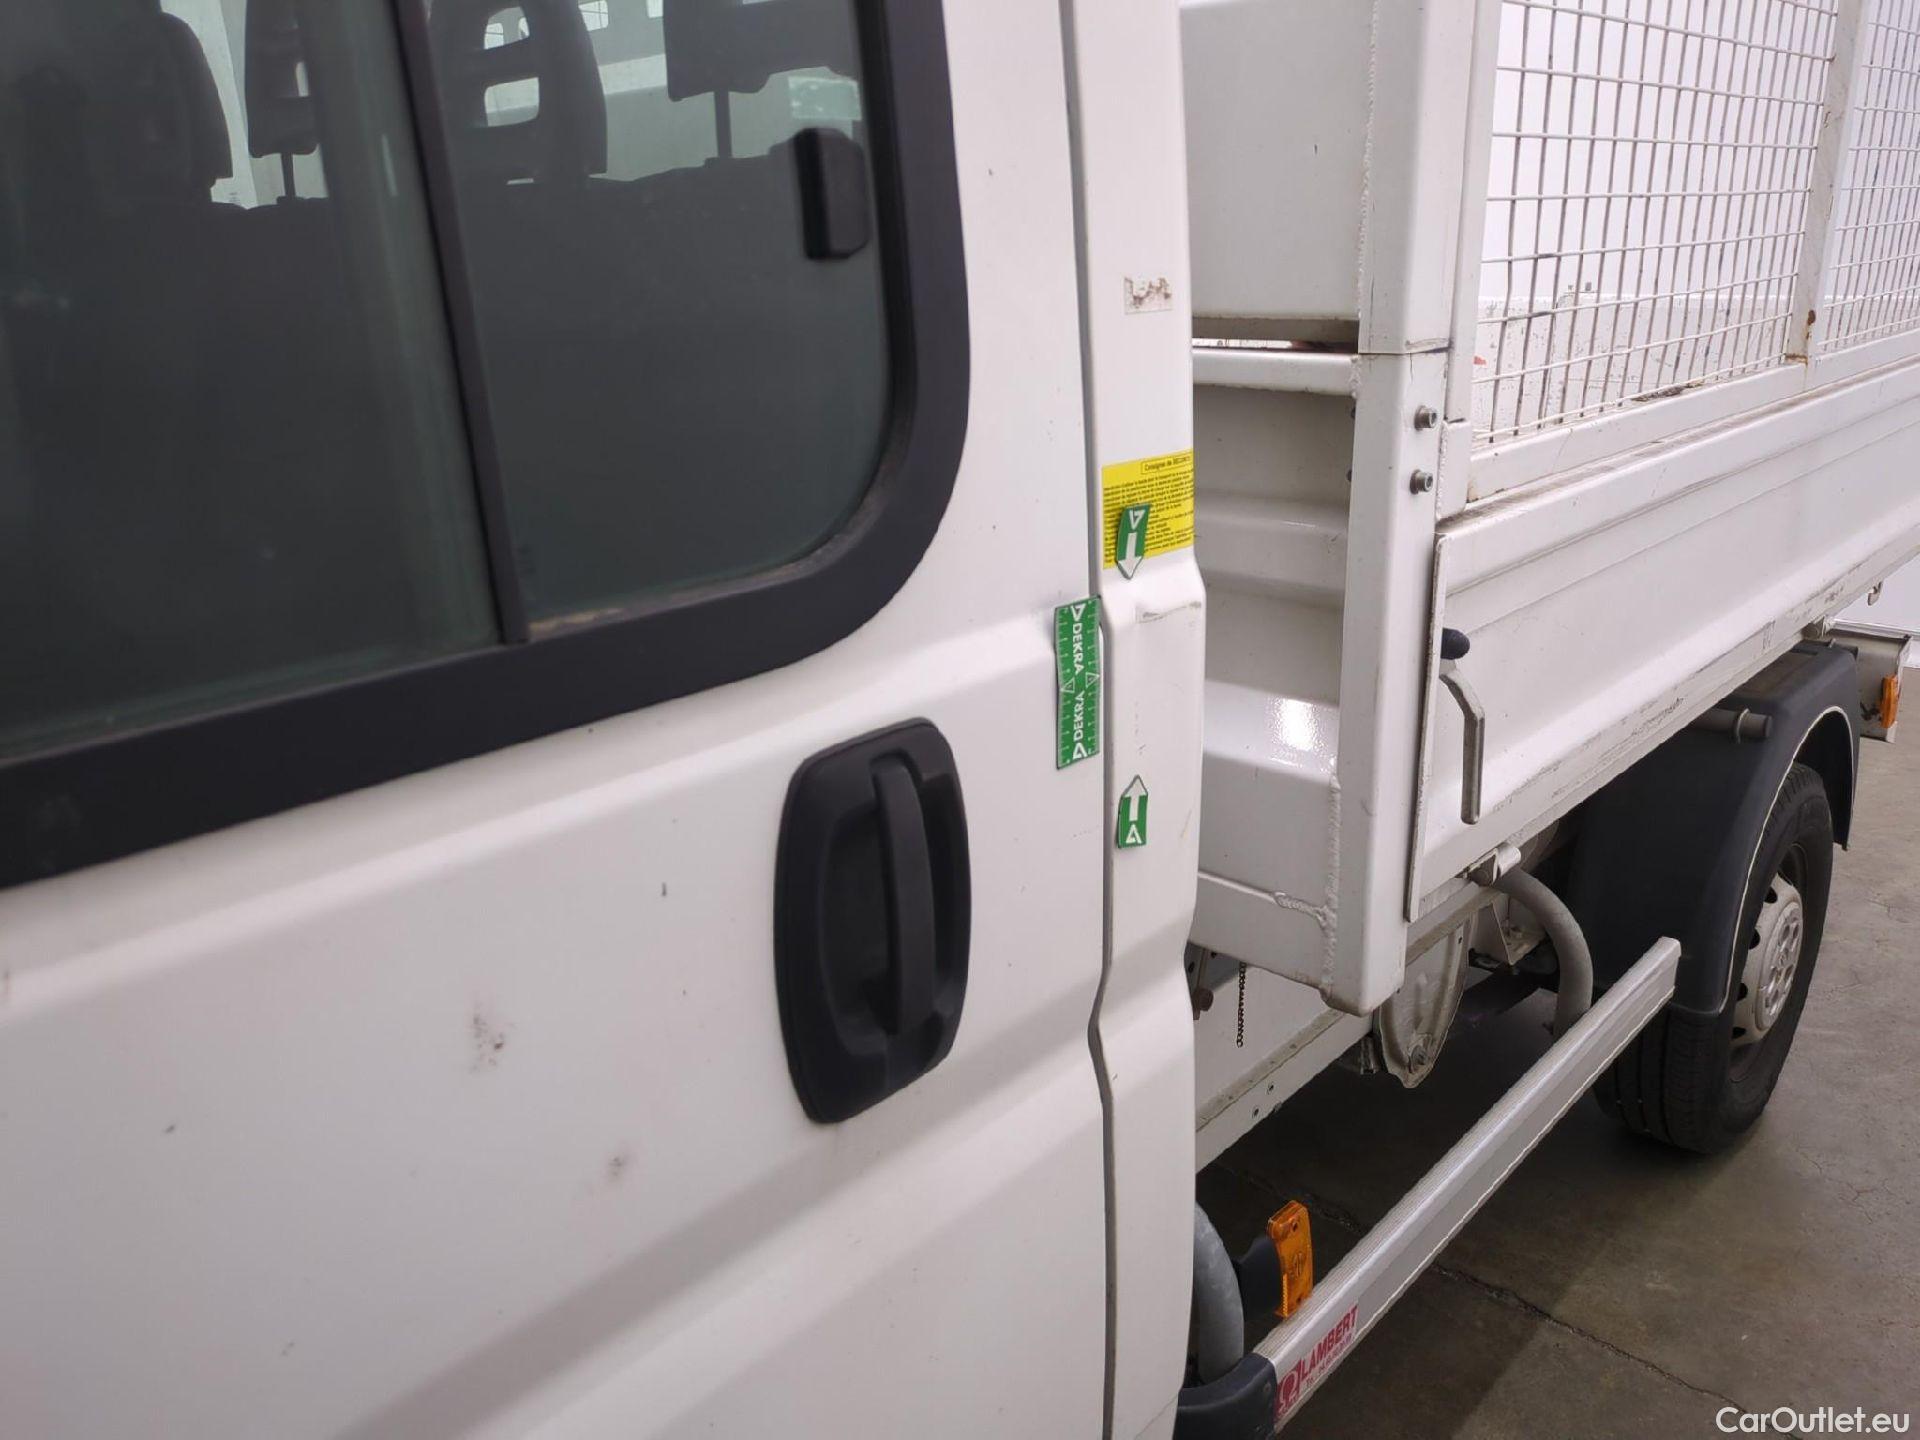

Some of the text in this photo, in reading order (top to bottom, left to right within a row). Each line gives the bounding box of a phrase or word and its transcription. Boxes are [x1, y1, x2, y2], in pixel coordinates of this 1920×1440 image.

[1072, 622, 1085, 675] DEKRA
[1073, 690, 1085, 741] DEKRA
[1301, 1305, 1358, 1380] LAMBERT
